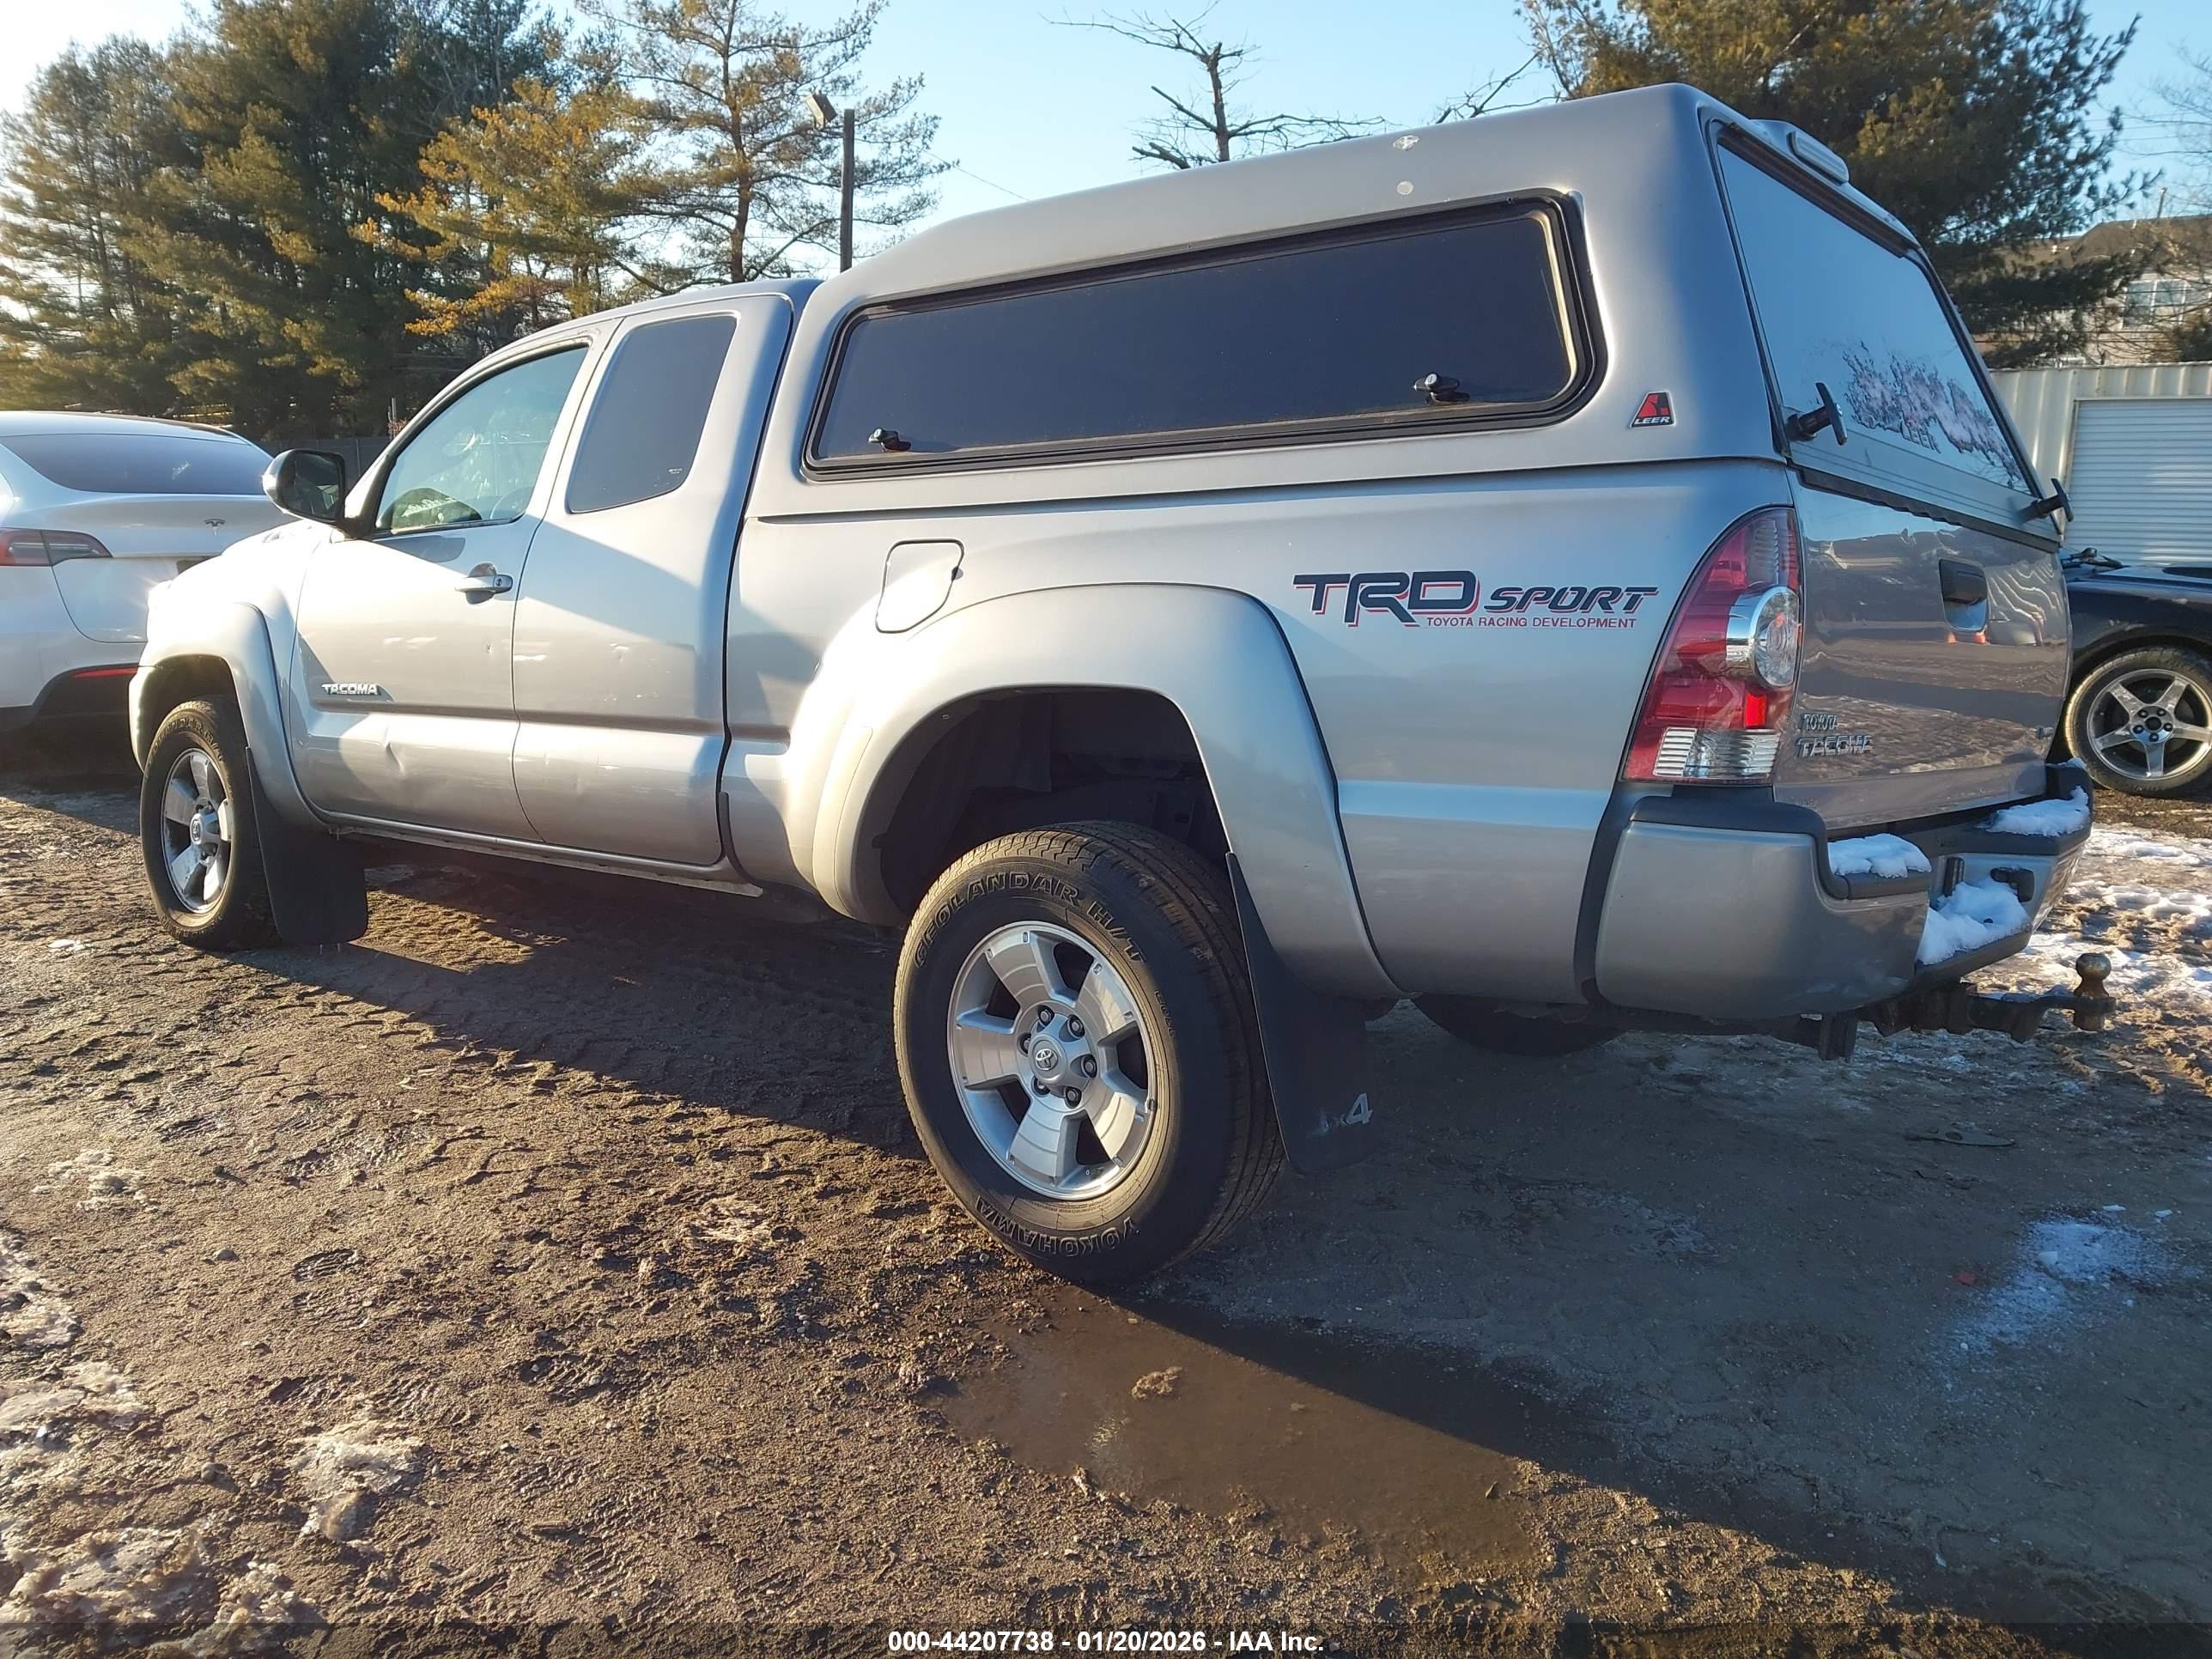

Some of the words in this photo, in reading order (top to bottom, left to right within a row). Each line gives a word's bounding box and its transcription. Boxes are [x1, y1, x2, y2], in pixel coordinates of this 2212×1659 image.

[1634, 416, 1670, 425] LEER
[1292, 570, 1480, 628] TRD
[1484, 586, 1658, 617] SPORT
[1426, 617, 1474, 627] TOYOTA
[1478, 617, 1528, 628] RACING
[1532, 617, 1638, 629] DEVELOPMENT
[321, 683, 379, 696] TACOMA
[914, 872, 1083, 968] GEOLANDAR
[1086, 901, 1147, 963] H/T
[975, 1194, 1140, 1256] YOKOHAMA
